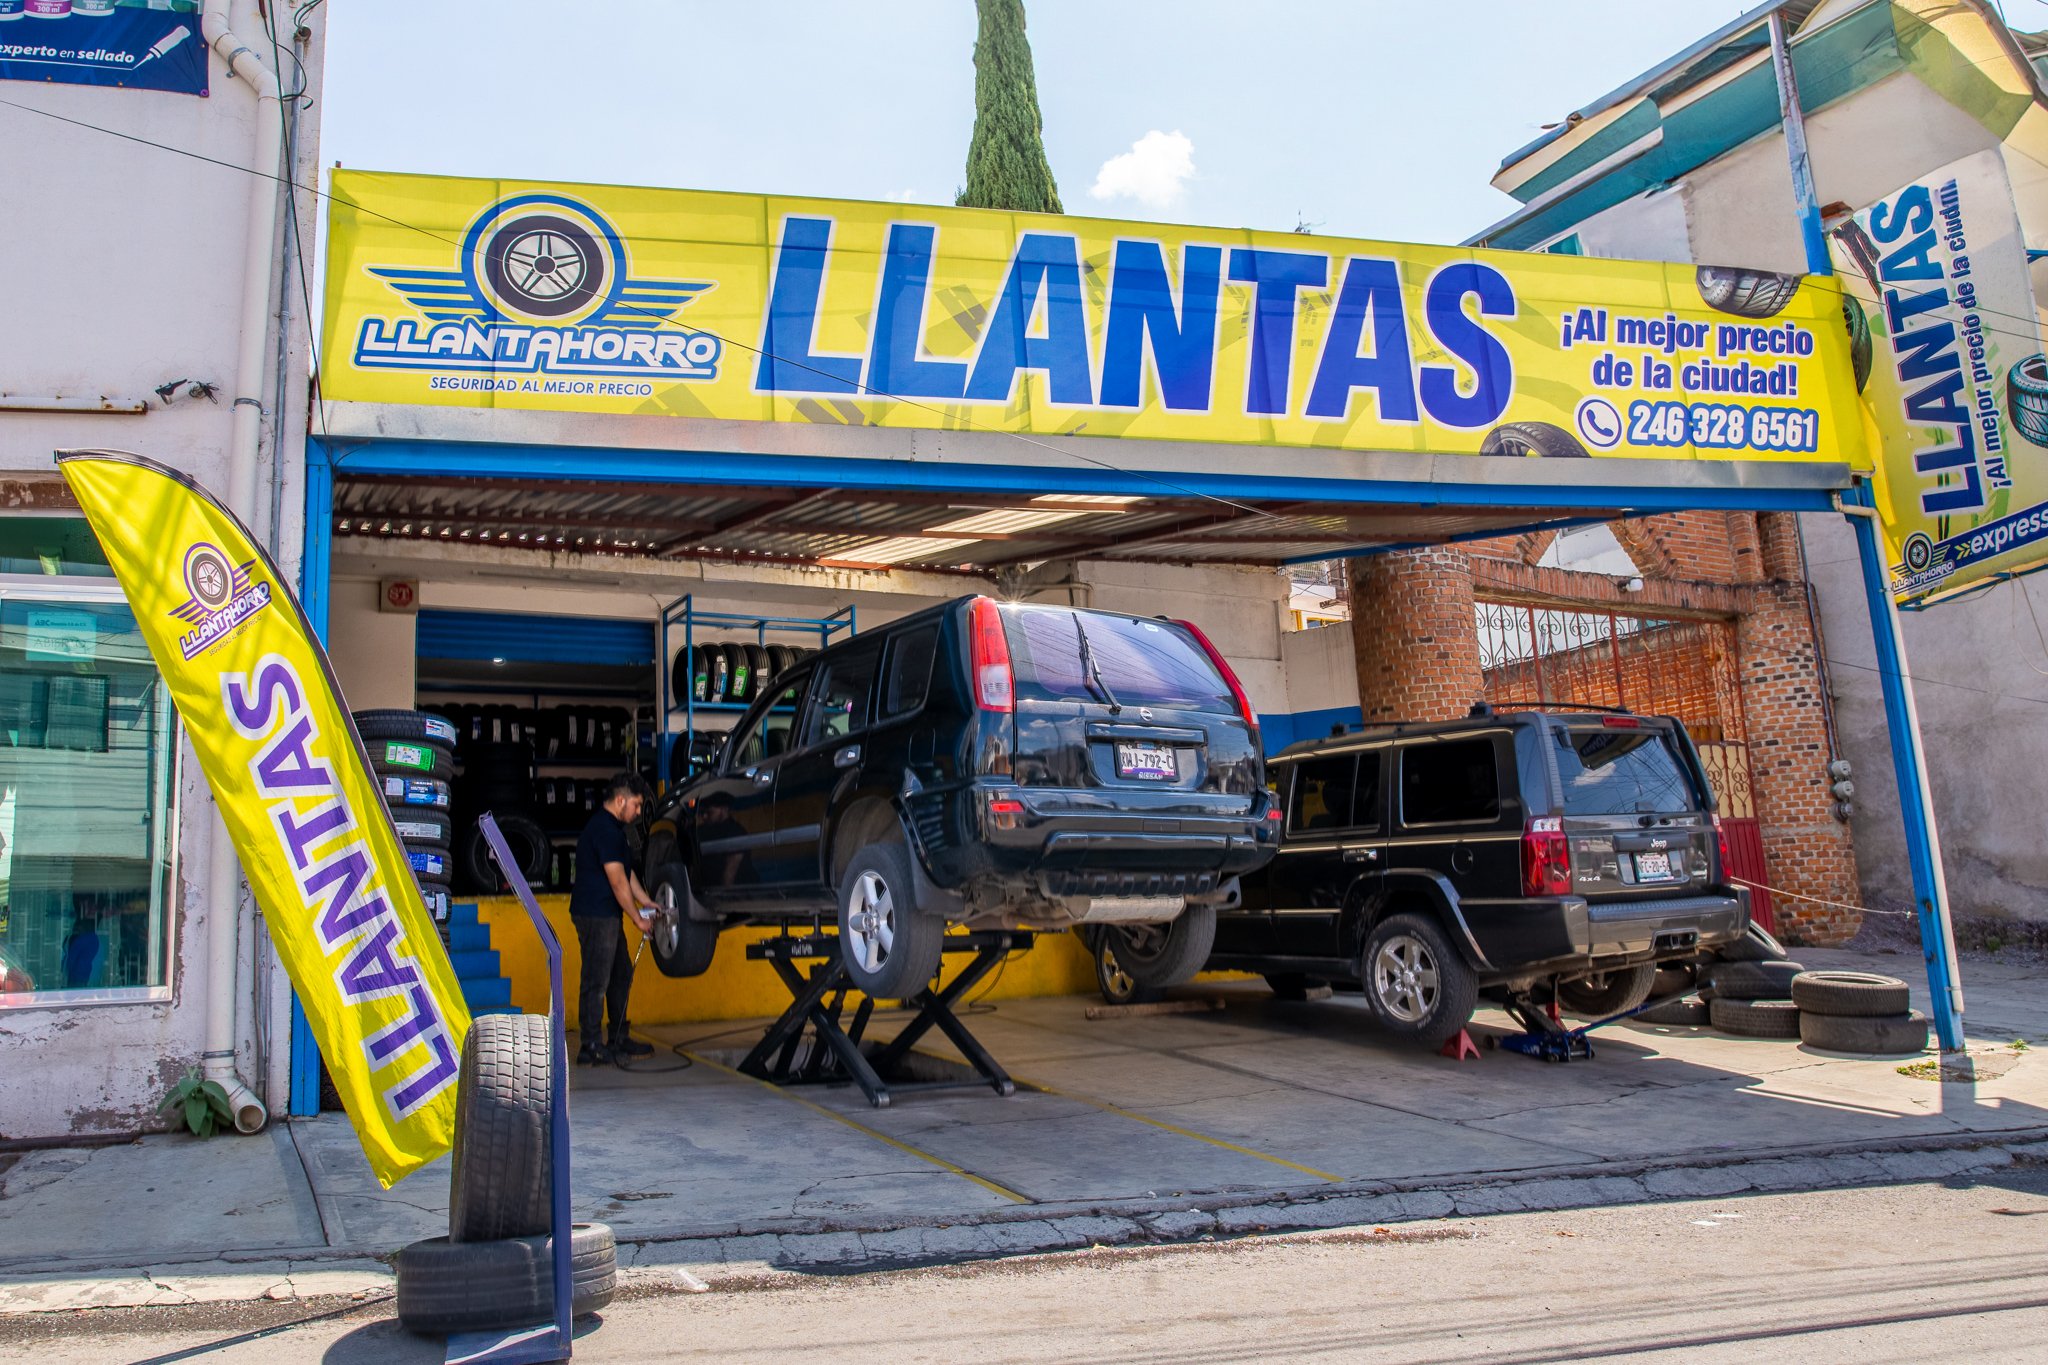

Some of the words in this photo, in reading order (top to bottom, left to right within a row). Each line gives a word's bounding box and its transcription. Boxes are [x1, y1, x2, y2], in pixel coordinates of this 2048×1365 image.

[37, 5, 50, 13] 300
[60, 50, 75, 58] en
[77, 49, 135, 63] sellado
[1951, 255, 1971, 279] la
[1955, 281, 1977, 310] de
[755, 217, 1516, 428] LLANTAS
[1562, 309, 1606, 347] ¡Al
[1617, 315, 1710, 352] mejor
[1718, 322, 1814, 357] precio
[360, 320, 720, 375] LLANTAHORRO
[1869, 184, 1984, 513] LLANTAS
[1961, 313, 1993, 383] precio
[430, 376, 517, 392] SEGURIDAD
[520, 380, 541, 393] AL
[543, 381, 594, 395] MEJOR
[598, 383, 653, 396] PRECIO
[1593, 354, 1633, 387] de
[1644, 356, 1672, 389] la
[1682, 360, 1797, 396] ciudad!
[1631, 405, 1686, 442] 246
[1693, 408, 1744, 445] 328
[1752, 412, 1815, 448] 6561
[1975, 389, 2002, 452] mejor
[1984, 457, 2012, 489] ¡Al
[1970, 509, 2048, 554] express
[1892, 561, 1954, 595] LLANTAHORRO
[180, 582, 271, 660] LLANTAHORRO
[1650, 838, 1667, 849] Jeep
[228, 662, 458, 1112] LLANTAS
